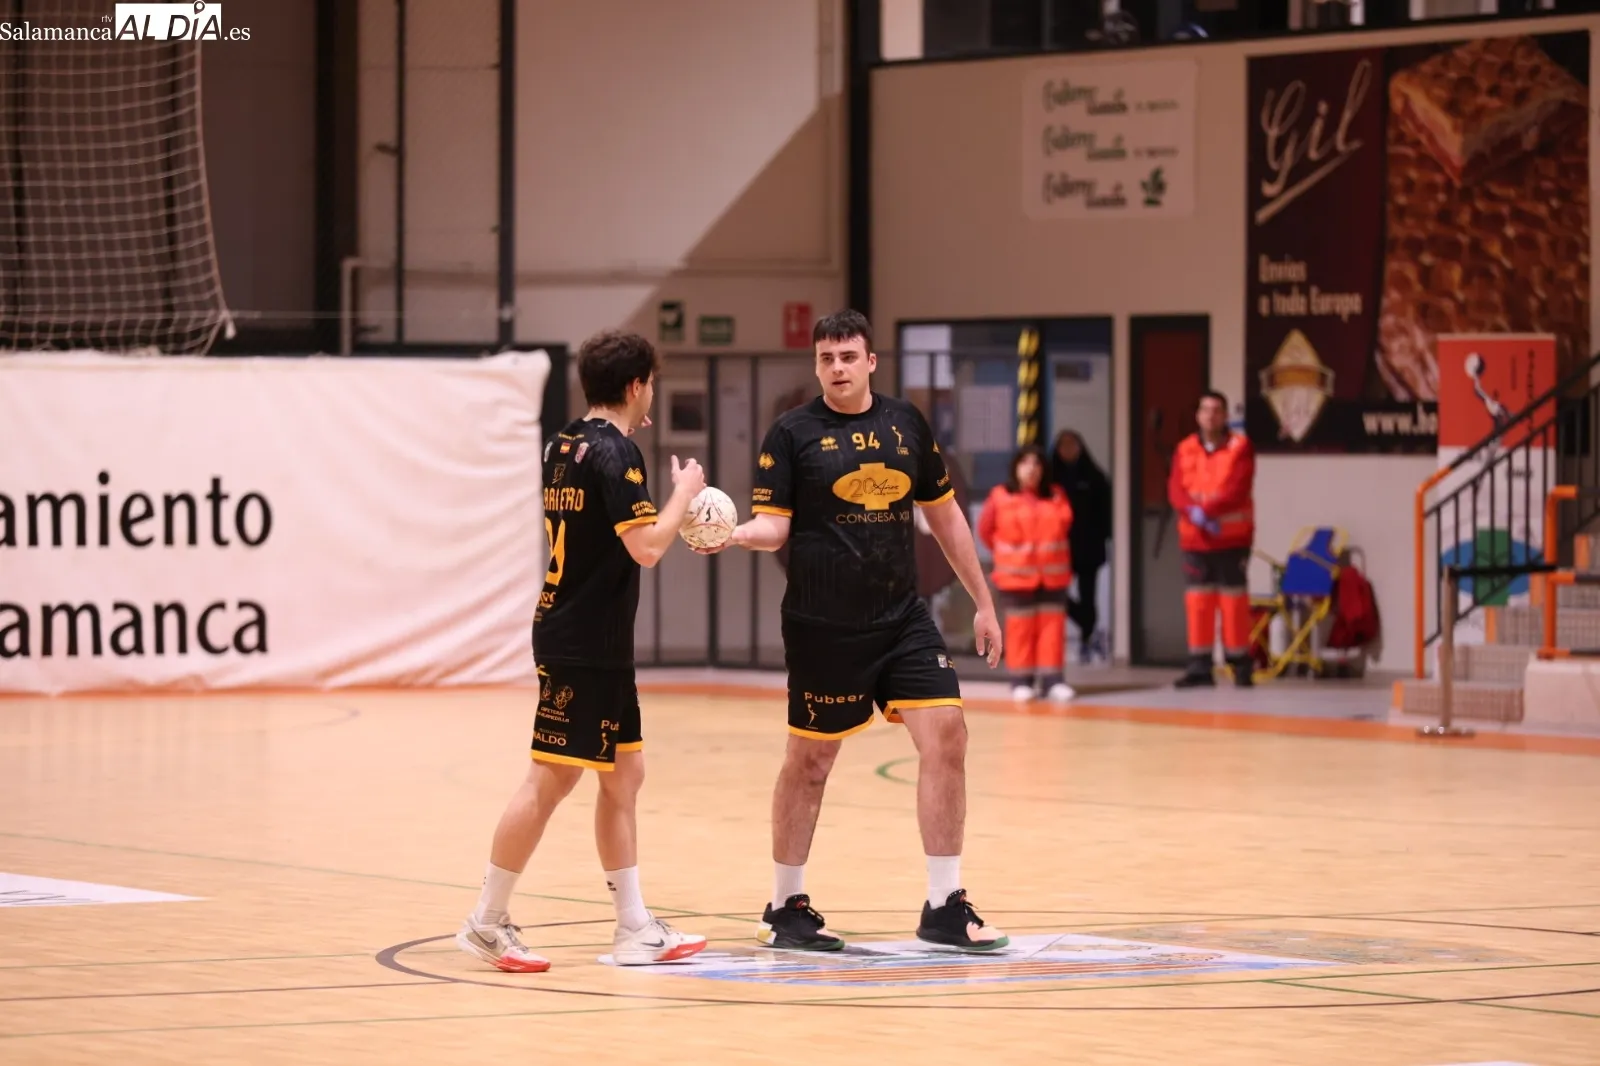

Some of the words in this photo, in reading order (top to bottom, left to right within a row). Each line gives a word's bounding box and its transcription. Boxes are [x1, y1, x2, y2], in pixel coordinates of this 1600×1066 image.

[851, 431, 881, 451] 94
[835, 511, 897, 525] CONGESA
[804, 691, 865, 705] Pubeer
[533, 731, 567, 747] ALDO
